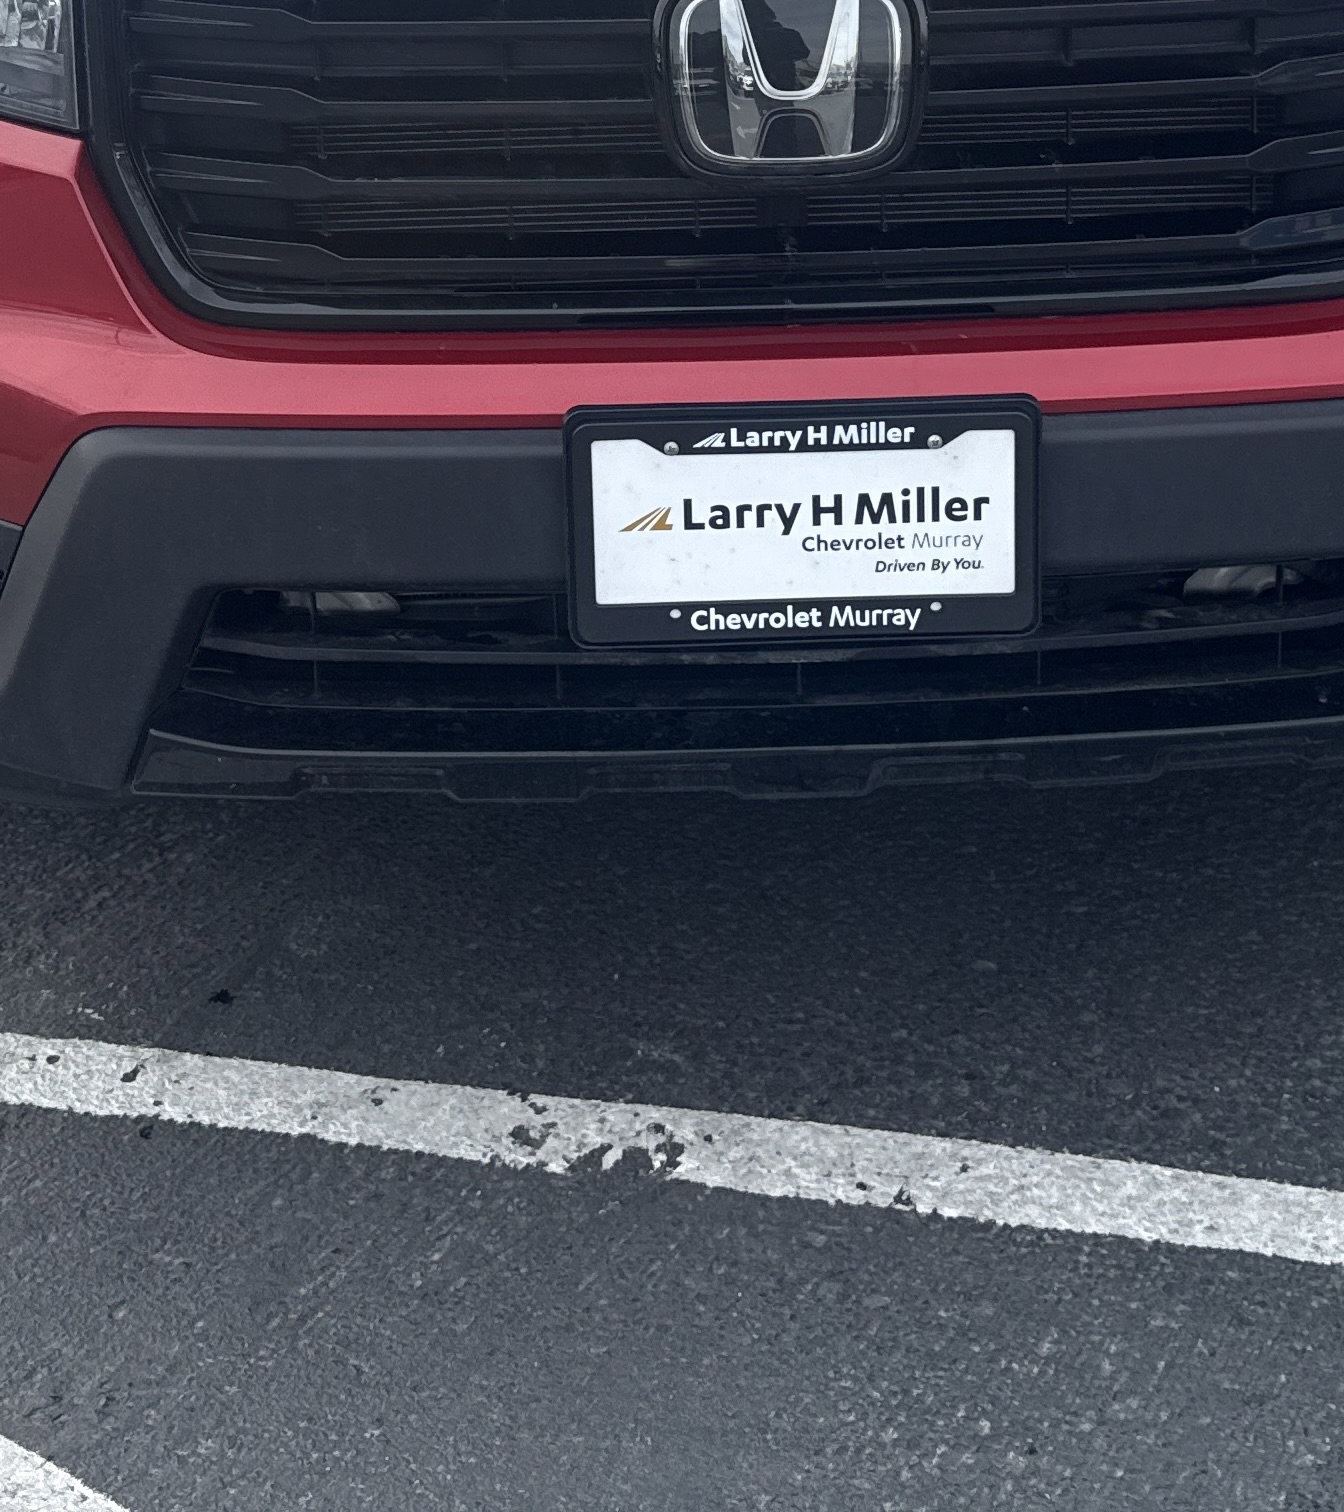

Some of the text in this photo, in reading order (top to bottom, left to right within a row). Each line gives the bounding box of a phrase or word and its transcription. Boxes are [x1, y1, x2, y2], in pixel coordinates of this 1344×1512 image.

[729, 420, 917, 451] Larry H Miller
[682, 485, 991, 537] Larry H Miller
[800, 531, 985, 553] Chevrolet Murray
[873, 557, 927, 574] Driven
[929, 557, 952, 574] By
[689, 603, 923, 631] Chevrolet Murray
